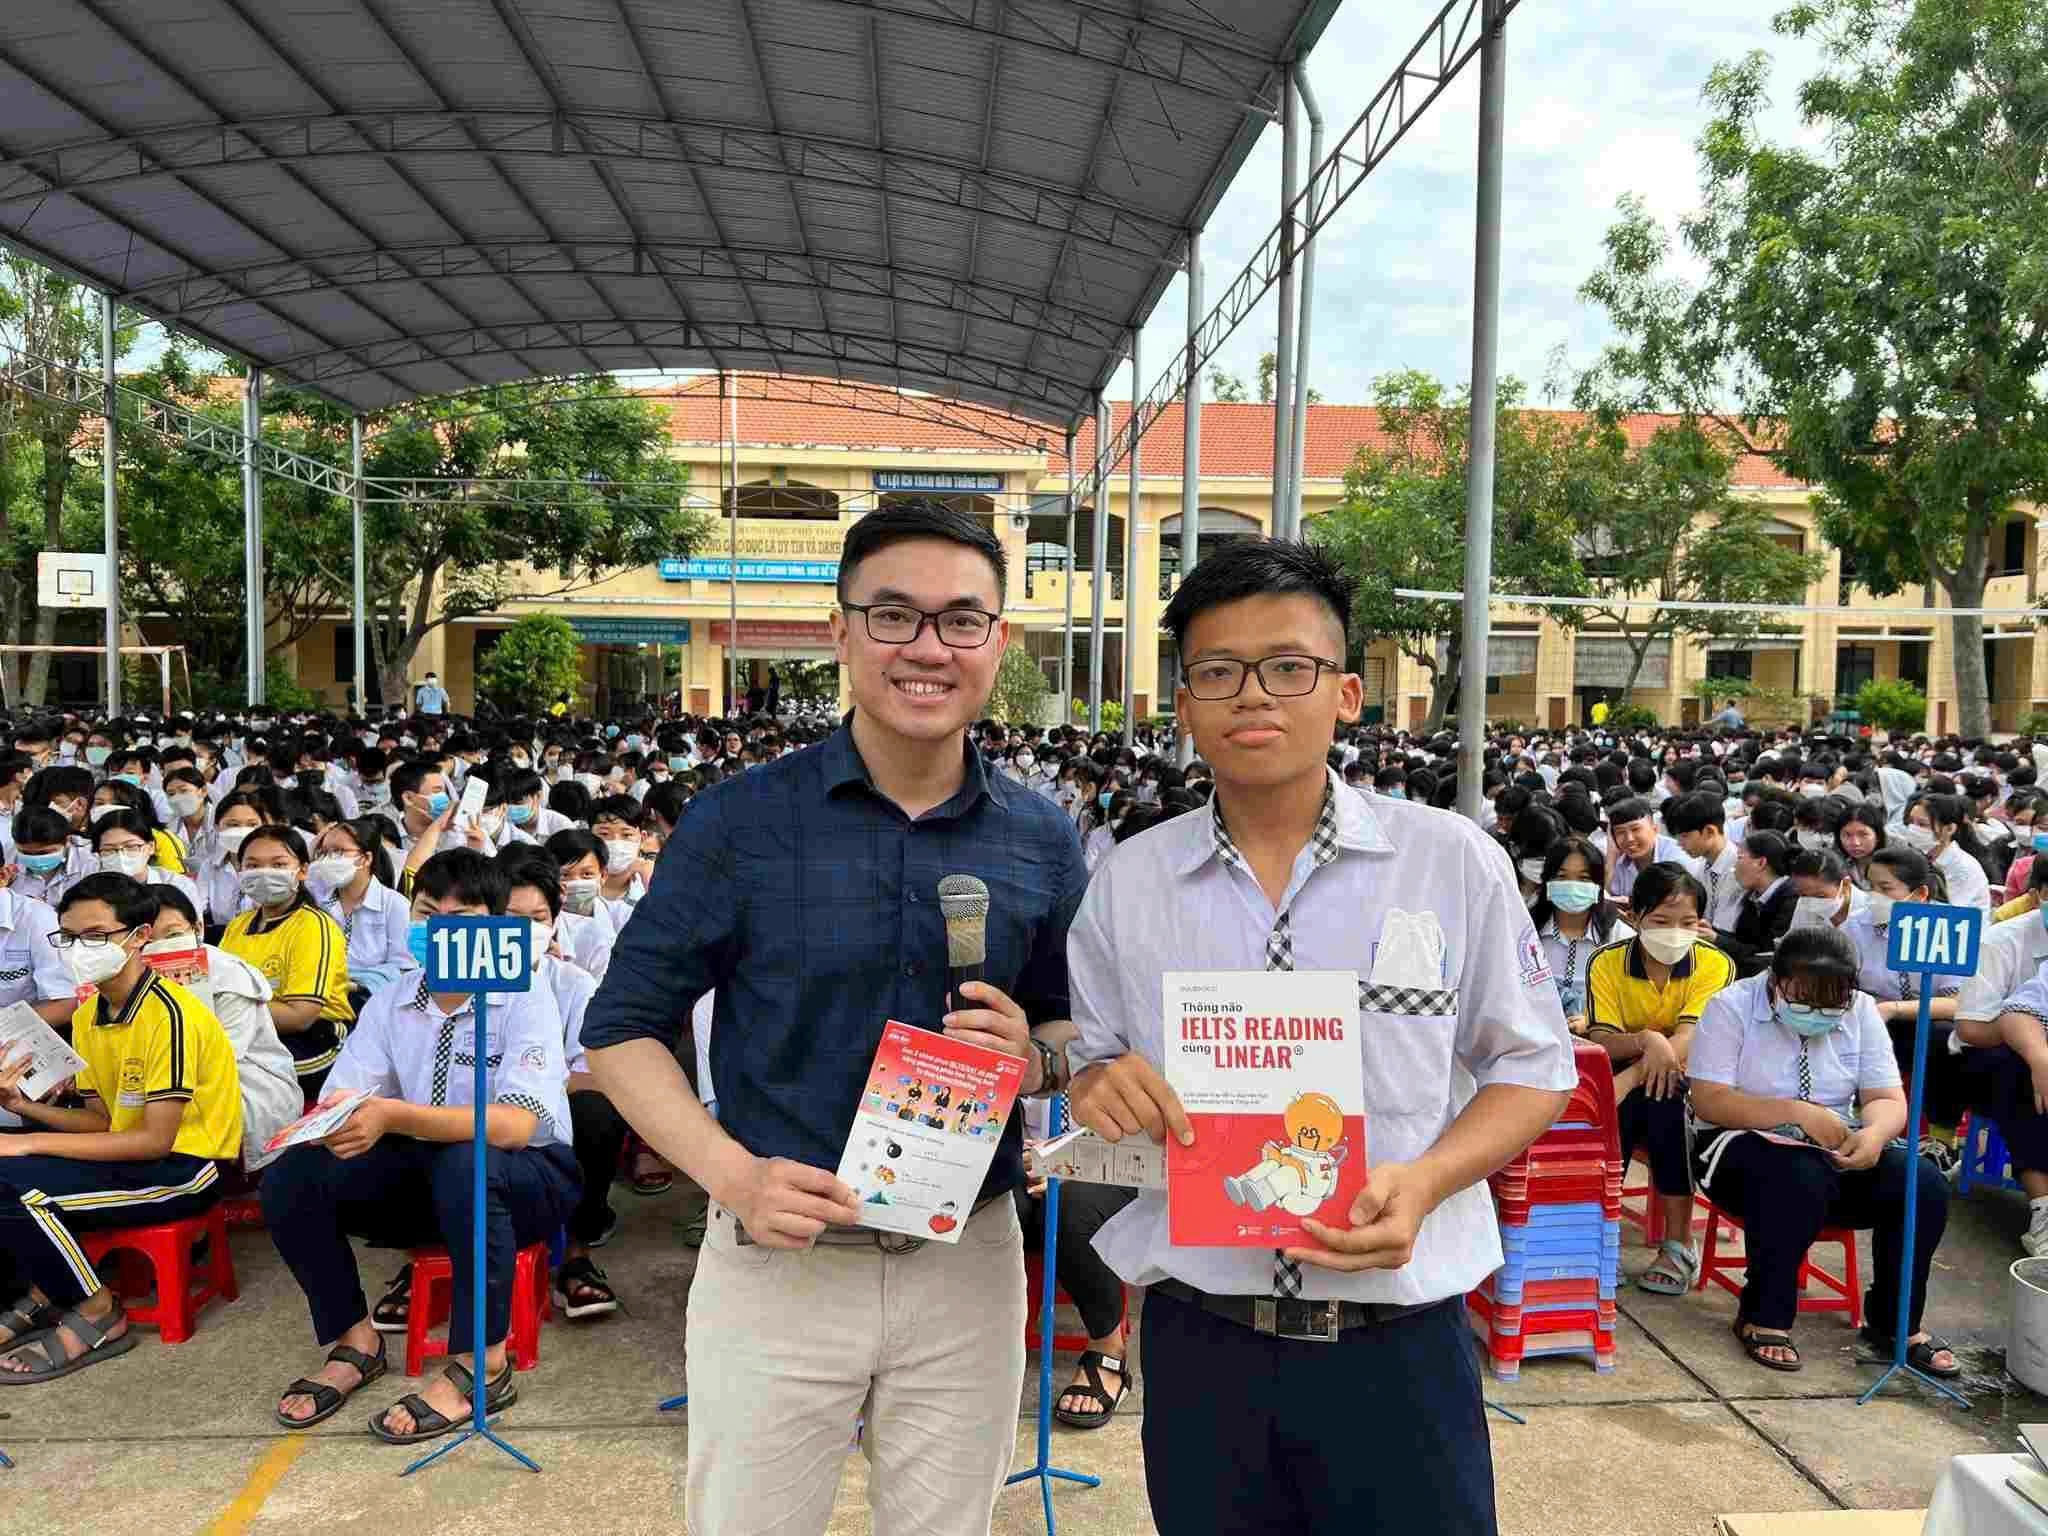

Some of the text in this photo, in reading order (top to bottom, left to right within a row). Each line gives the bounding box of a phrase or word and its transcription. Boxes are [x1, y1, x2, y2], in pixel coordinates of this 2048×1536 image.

[1898, 915, 1970, 965] 11A1
[432, 927, 522, 979] 11A5
[1182, 1001, 1243, 1014] Thông não
[1182, 1017, 1344, 1041] IELTS READING
[1181, 1043, 1211, 1056] cùng
